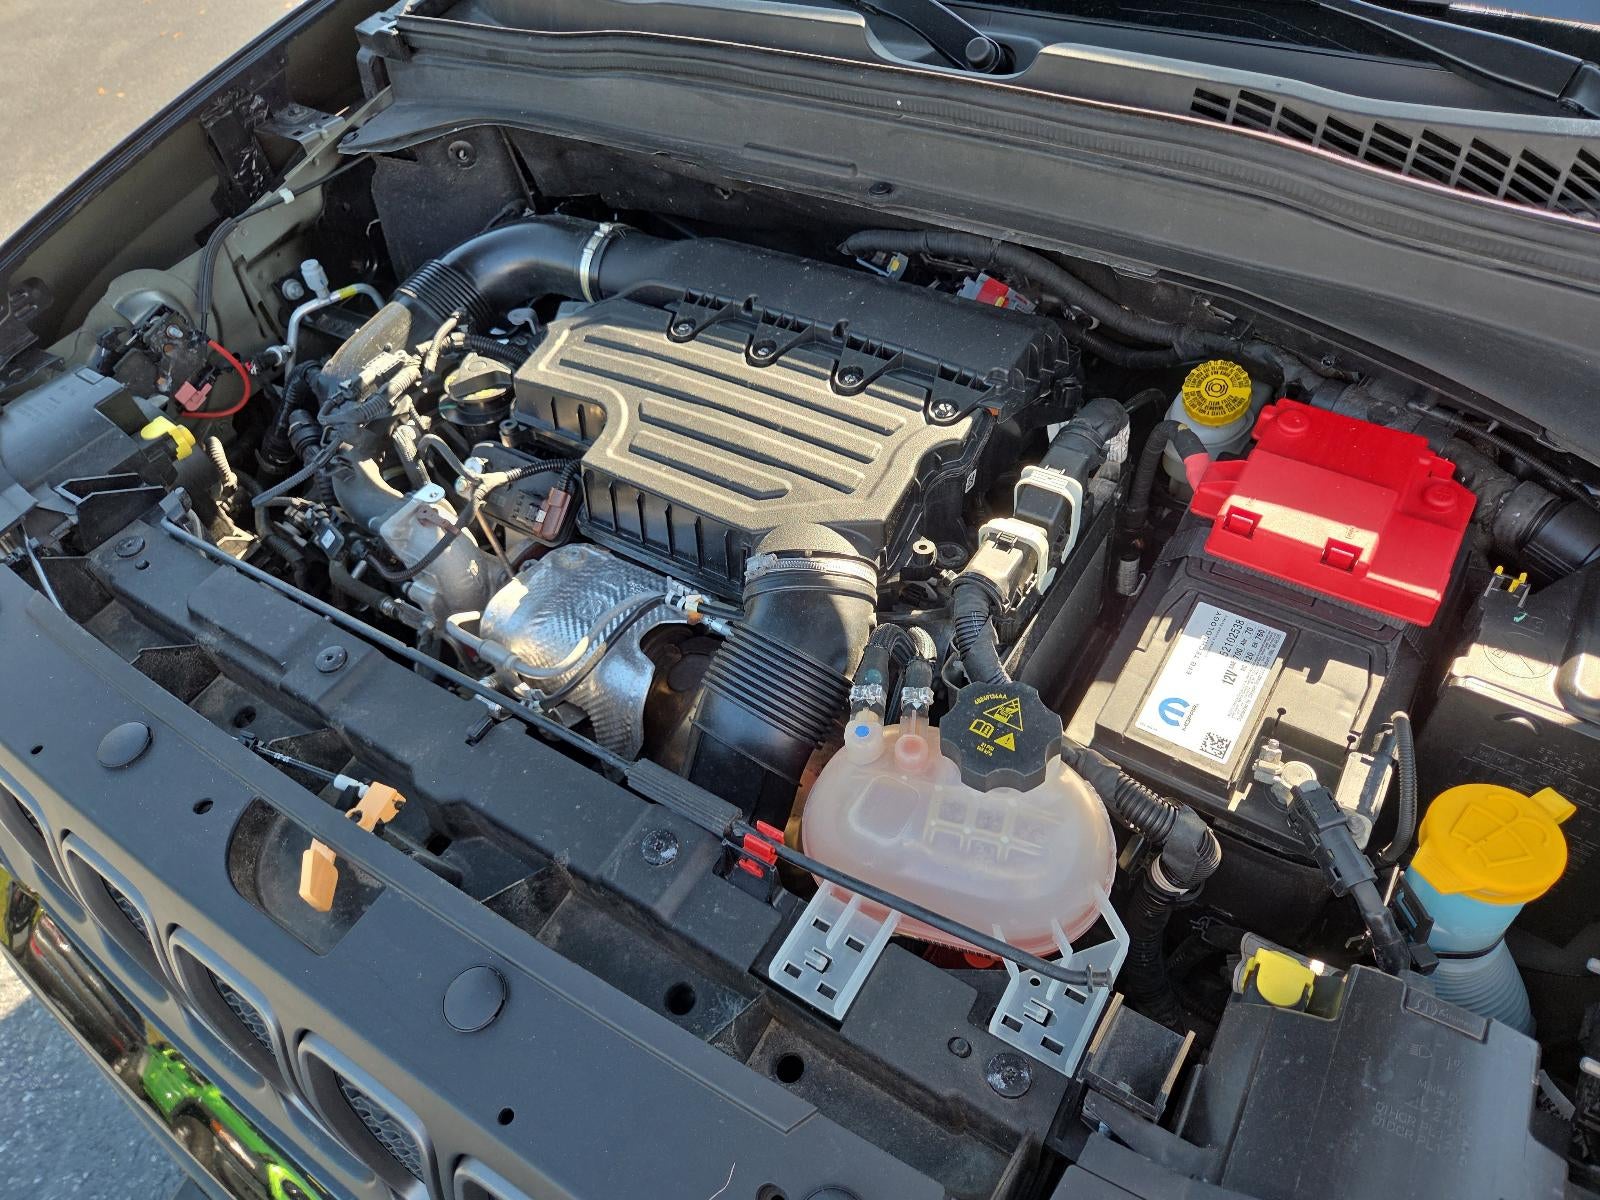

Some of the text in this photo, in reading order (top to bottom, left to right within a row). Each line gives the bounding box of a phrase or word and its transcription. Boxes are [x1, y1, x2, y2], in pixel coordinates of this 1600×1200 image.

[1193, 610, 1222, 659] TECHNOLOGY
[1221, 668, 1237, 686] 12V
[1244, 626, 1253, 635] 70
